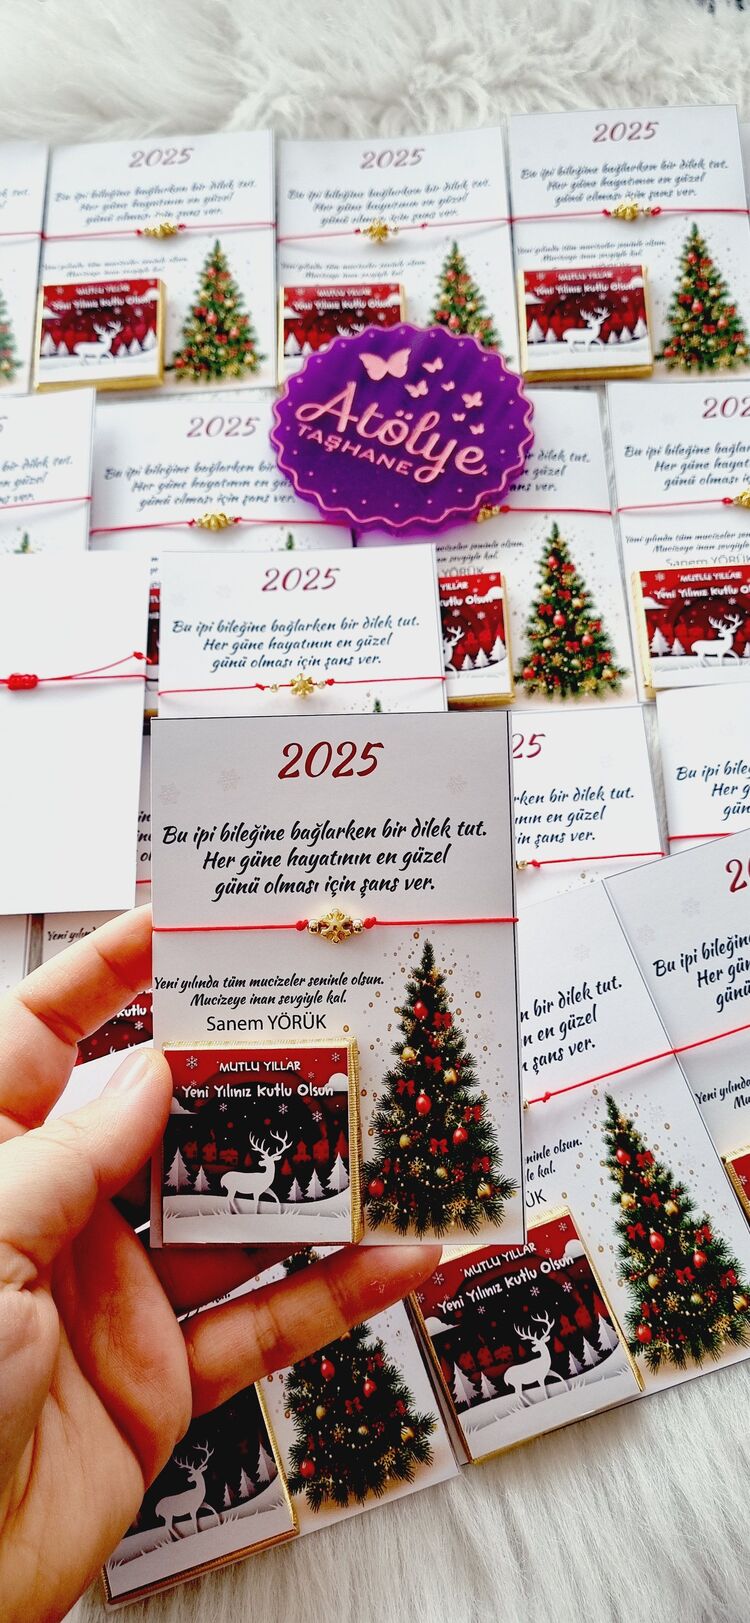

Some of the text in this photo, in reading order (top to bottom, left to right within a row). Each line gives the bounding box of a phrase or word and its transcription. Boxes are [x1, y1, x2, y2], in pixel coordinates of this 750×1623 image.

[592, 121, 659, 143] 2025
[128, 147, 195, 168] 2025
[360, 148, 425, 169] 2025
[186, 416, 260, 438] 2025
[297, 424, 414, 476] TAŞHANE
[624, 444, 642, 458] Bu
[645, 445, 661, 460] ipi
[654, 460, 677, 472] Her
[510, 483, 531, 491] ans
[261, 567, 341, 592] 2025
[172, 613, 420, 638] Bu ipi bileğine bağlarken bir dilek tut.
[203, 631, 393, 655] Her güne hayatının en güzel
[209, 652, 382, 673] günü olması için şans ver.
[277, 741, 384, 780] 2025
[676, 766, 696, 781] Bu
[701, 764, 721, 782] ipi
[549, 787, 569, 803] bir
[572, 785, 605, 802] dilek
[609, 786, 634, 800] tut.
[712, 782, 738, 797] Her
[546, 814, 563, 824] en
[565, 804, 607, 827] güzel
[162, 825, 188, 845] Bu
[193, 825, 216, 850] ipi
[220, 820, 285, 849] bileğine
[290, 819, 376, 848] bağlarken
[382, 820, 407, 840] bir
[411, 816, 452, 840] dilek
[456, 818, 488, 838] tut.
[534, 830, 566, 849] şans
[570, 828, 596, 842] ver.
[202, 842, 453, 876] Her güne hayatının en güzel
[210, 872, 436, 903] günü olması için şans ver.
[653, 959, 676, 977] Bu
[680, 948, 698, 974] ipi
[154, 971, 385, 993] Yeni yılında tüm mucizeler seninle olsun.
[697, 969, 724, 988] Her
[190, 989, 347, 1010] Mucizeye inan sevgiyle kal.
[534, 998, 554, 1017] bir
[558, 981, 593, 1009] dilek
[596, 975, 623, 996] tut.
[206, 1012, 327, 1032] Sanem YÖRÜK
[537, 1026, 555, 1041] en
[559, 1003, 598, 1041] güzel
[532, 1047, 565, 1075] şans
[568, 1037, 596, 1056] ver.
[219, 1061, 301, 1073] MUTLU YILLAR
[181, 1085, 210, 1099] Yeni
[213, 1083, 252, 1098] Yılınız
[297, 1082, 334, 1097] Olsun
[694, 1088, 717, 1105] Yeni
[553, 1138, 583, 1155] olsun.
[537, 1159, 556, 1177] kal.
[464, 1241, 537, 1279] MUTLU YILLAR
[437, 1295, 465, 1315] Yeni
[466, 1282, 503, 1304] Yılınız
[540, 1256, 575, 1274] Olsun
